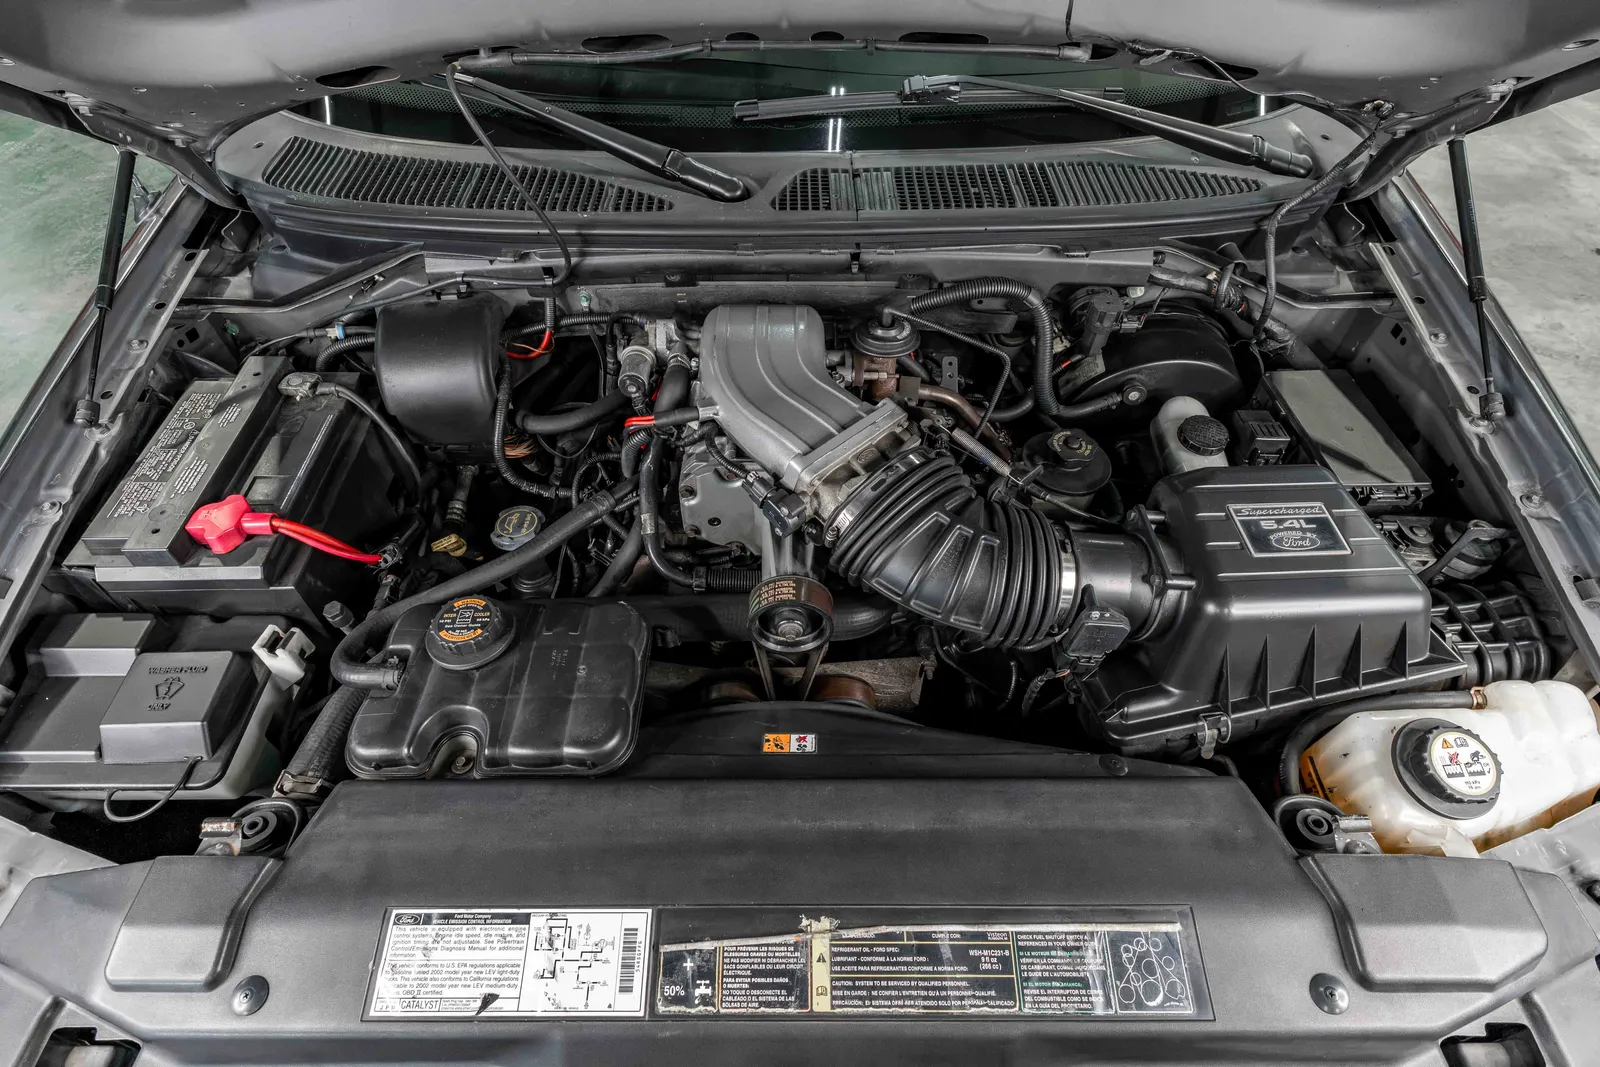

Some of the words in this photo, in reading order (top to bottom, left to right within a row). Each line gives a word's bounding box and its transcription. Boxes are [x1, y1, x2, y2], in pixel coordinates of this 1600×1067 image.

[1237, 507, 1322, 516] Supercharged
[1260, 520, 1316, 529] 5.4L
[1270, 531, 1302, 539] POWERED
[1283, 536, 1311, 546] Ford
[148, 666, 183, 674] WASHER
[148, 703, 171, 711] ONLY
[664, 985, 684, 996] 50%
[401, 1000, 438, 1009] CATALYST
